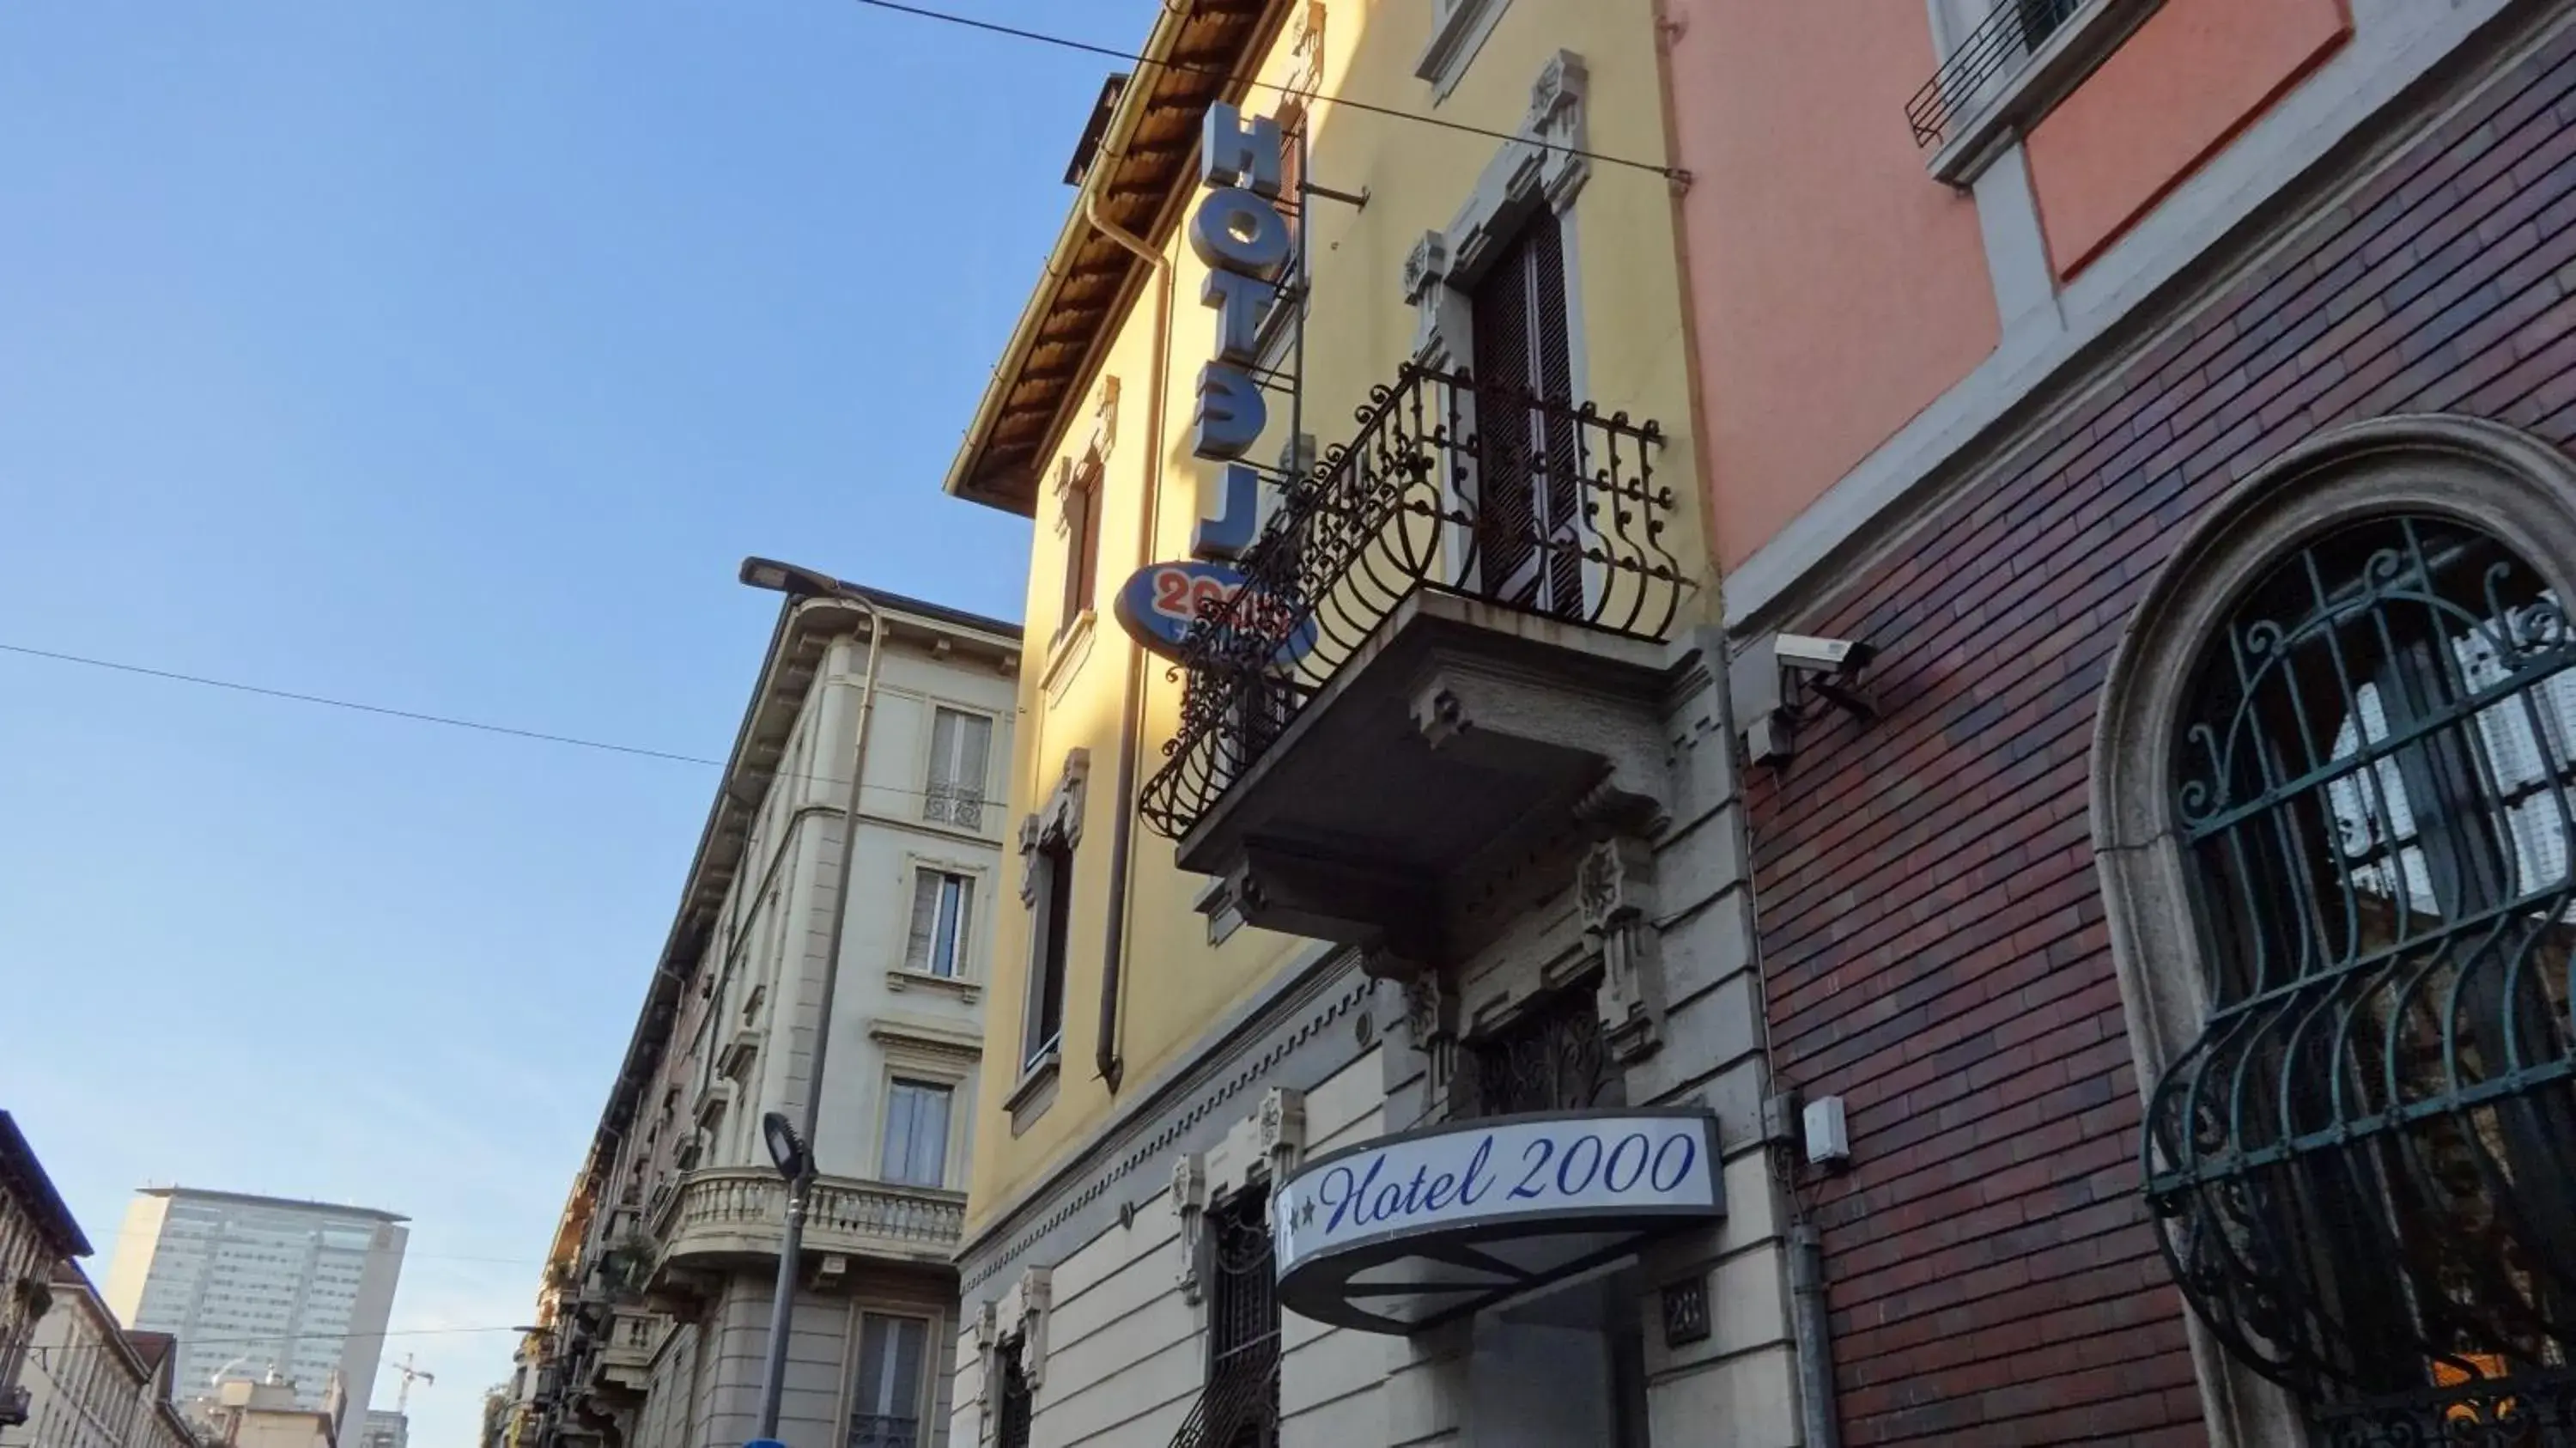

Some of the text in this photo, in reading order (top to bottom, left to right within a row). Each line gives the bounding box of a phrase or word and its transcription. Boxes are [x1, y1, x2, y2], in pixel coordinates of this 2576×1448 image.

[1152, 569, 1292, 642] 20
[1319, 1132, 1696, 1235] Hotel 2000
